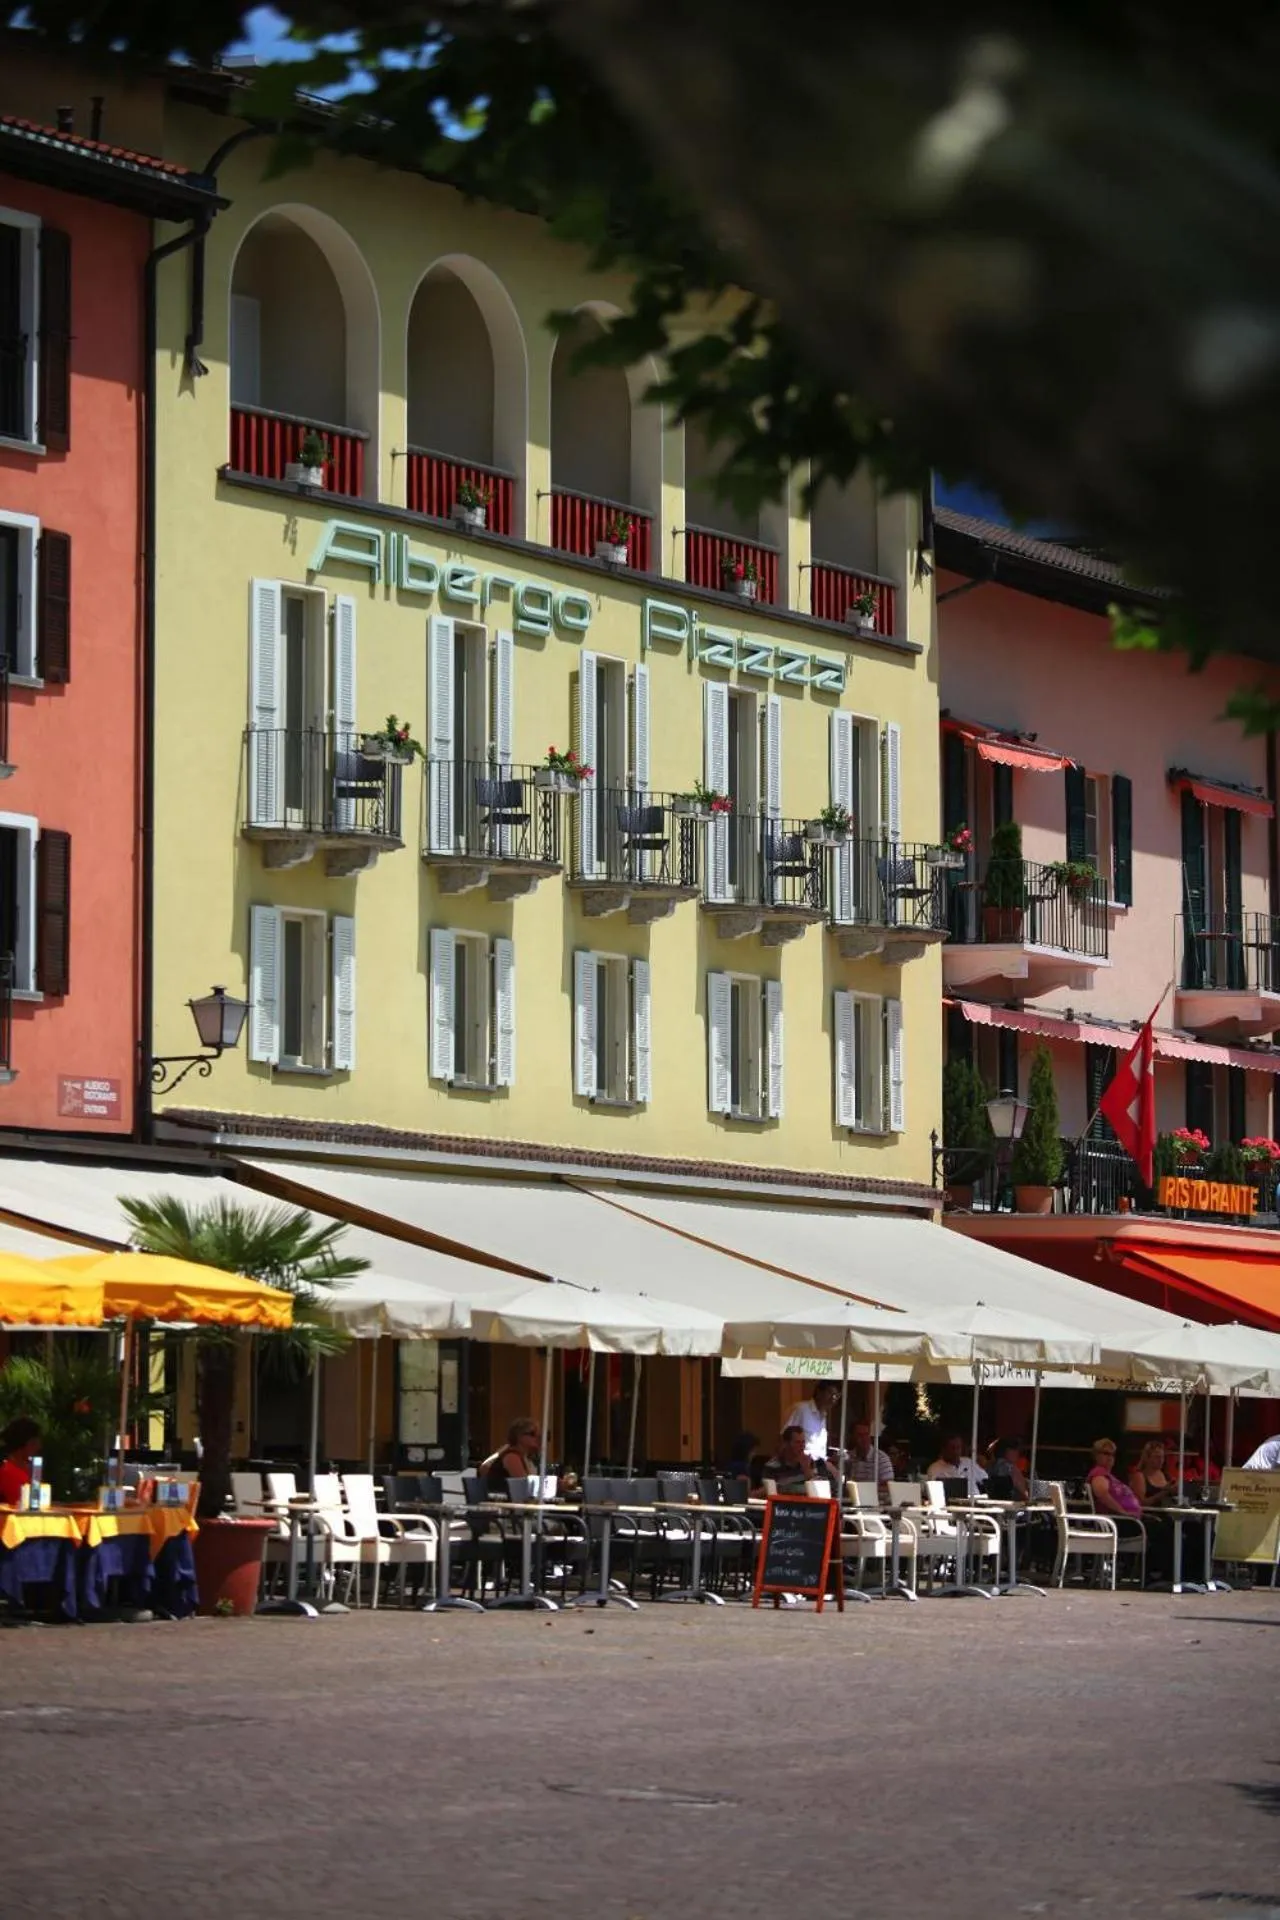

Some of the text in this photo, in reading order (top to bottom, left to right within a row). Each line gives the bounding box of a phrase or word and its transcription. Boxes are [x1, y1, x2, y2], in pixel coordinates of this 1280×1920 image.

[307, 519, 846, 694] Albergo Piazza
[1165, 1177, 1259, 1216] RISTORANTE
